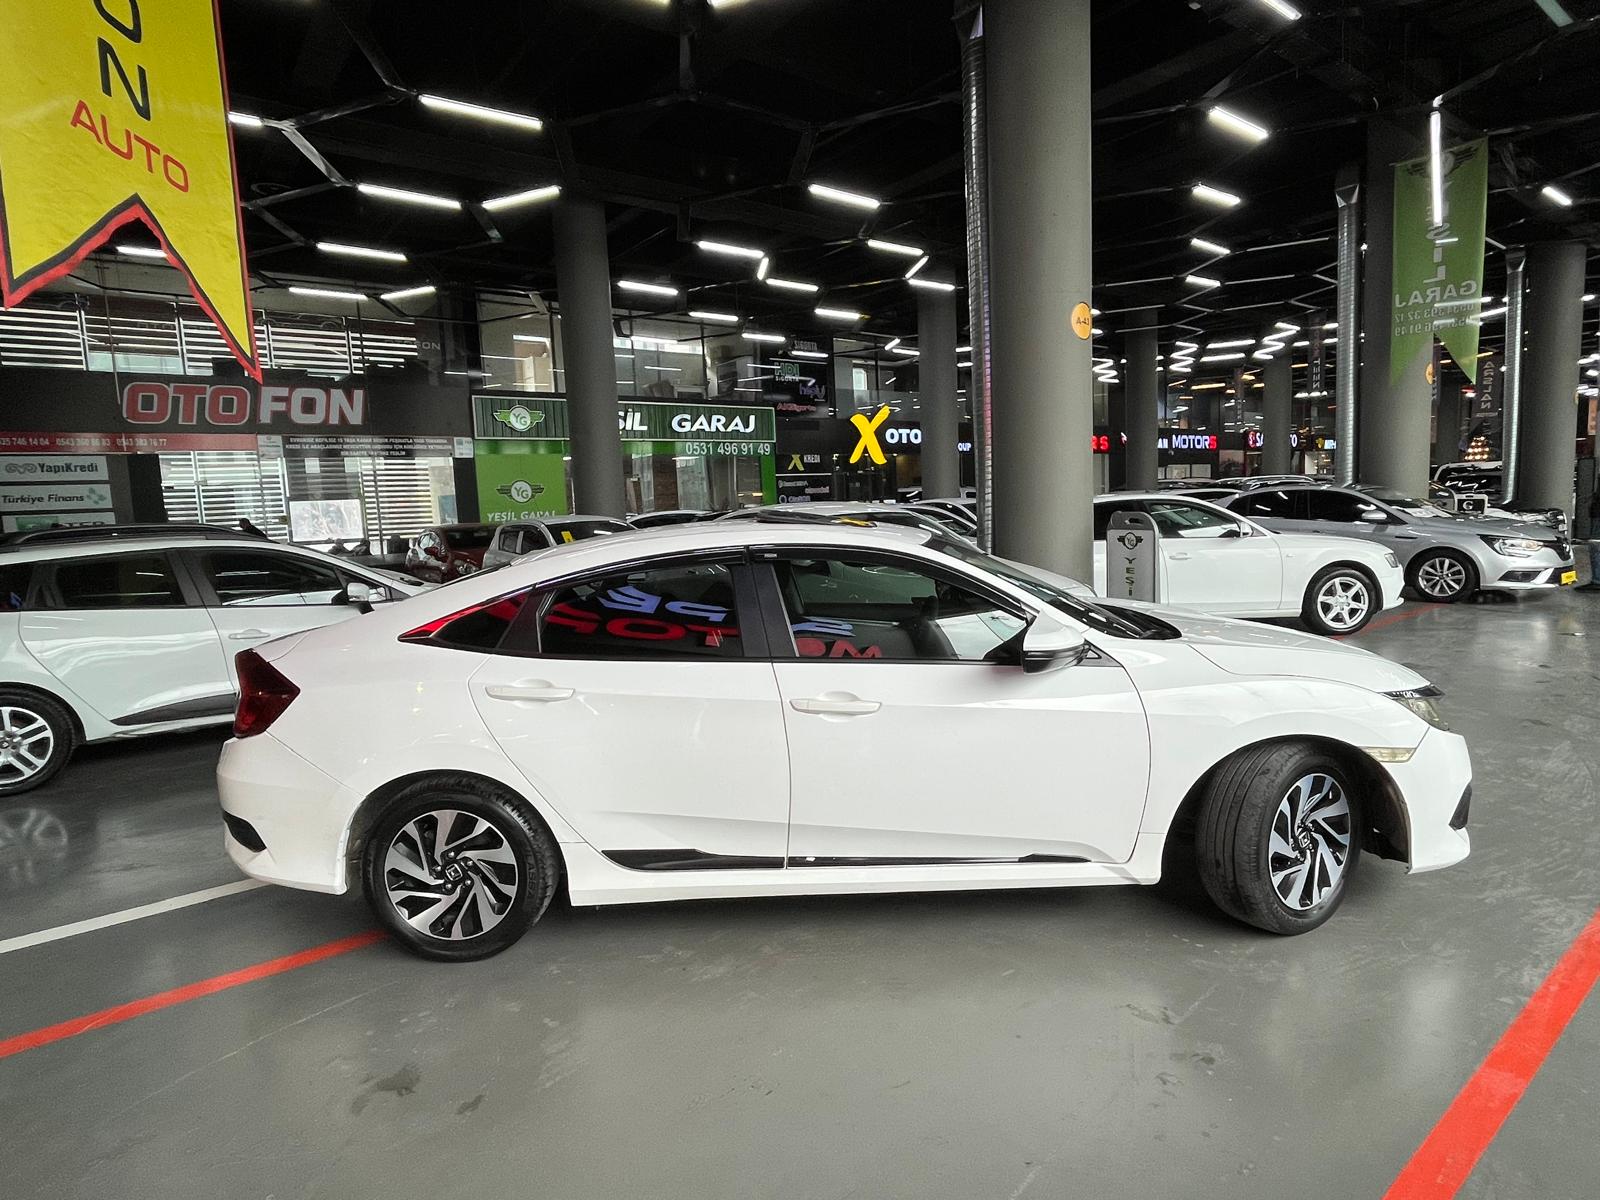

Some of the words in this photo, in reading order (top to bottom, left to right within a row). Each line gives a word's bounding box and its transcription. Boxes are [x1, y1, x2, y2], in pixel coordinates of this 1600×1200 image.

[70, 100, 189, 192] AUTO
[671, 413, 756, 433] GARAJ
[885, 428, 921, 444] OTO
[1172, 434, 1217, 450] MOTORS
[686, 442, 713, 455] 0531
[717, 443, 738, 455] 496
[741, 443, 754, 455] 91
[757, 444, 771, 455] 49
[2, 494, 44, 504] Türkiye
[48, 494, 84, 502] Finans
